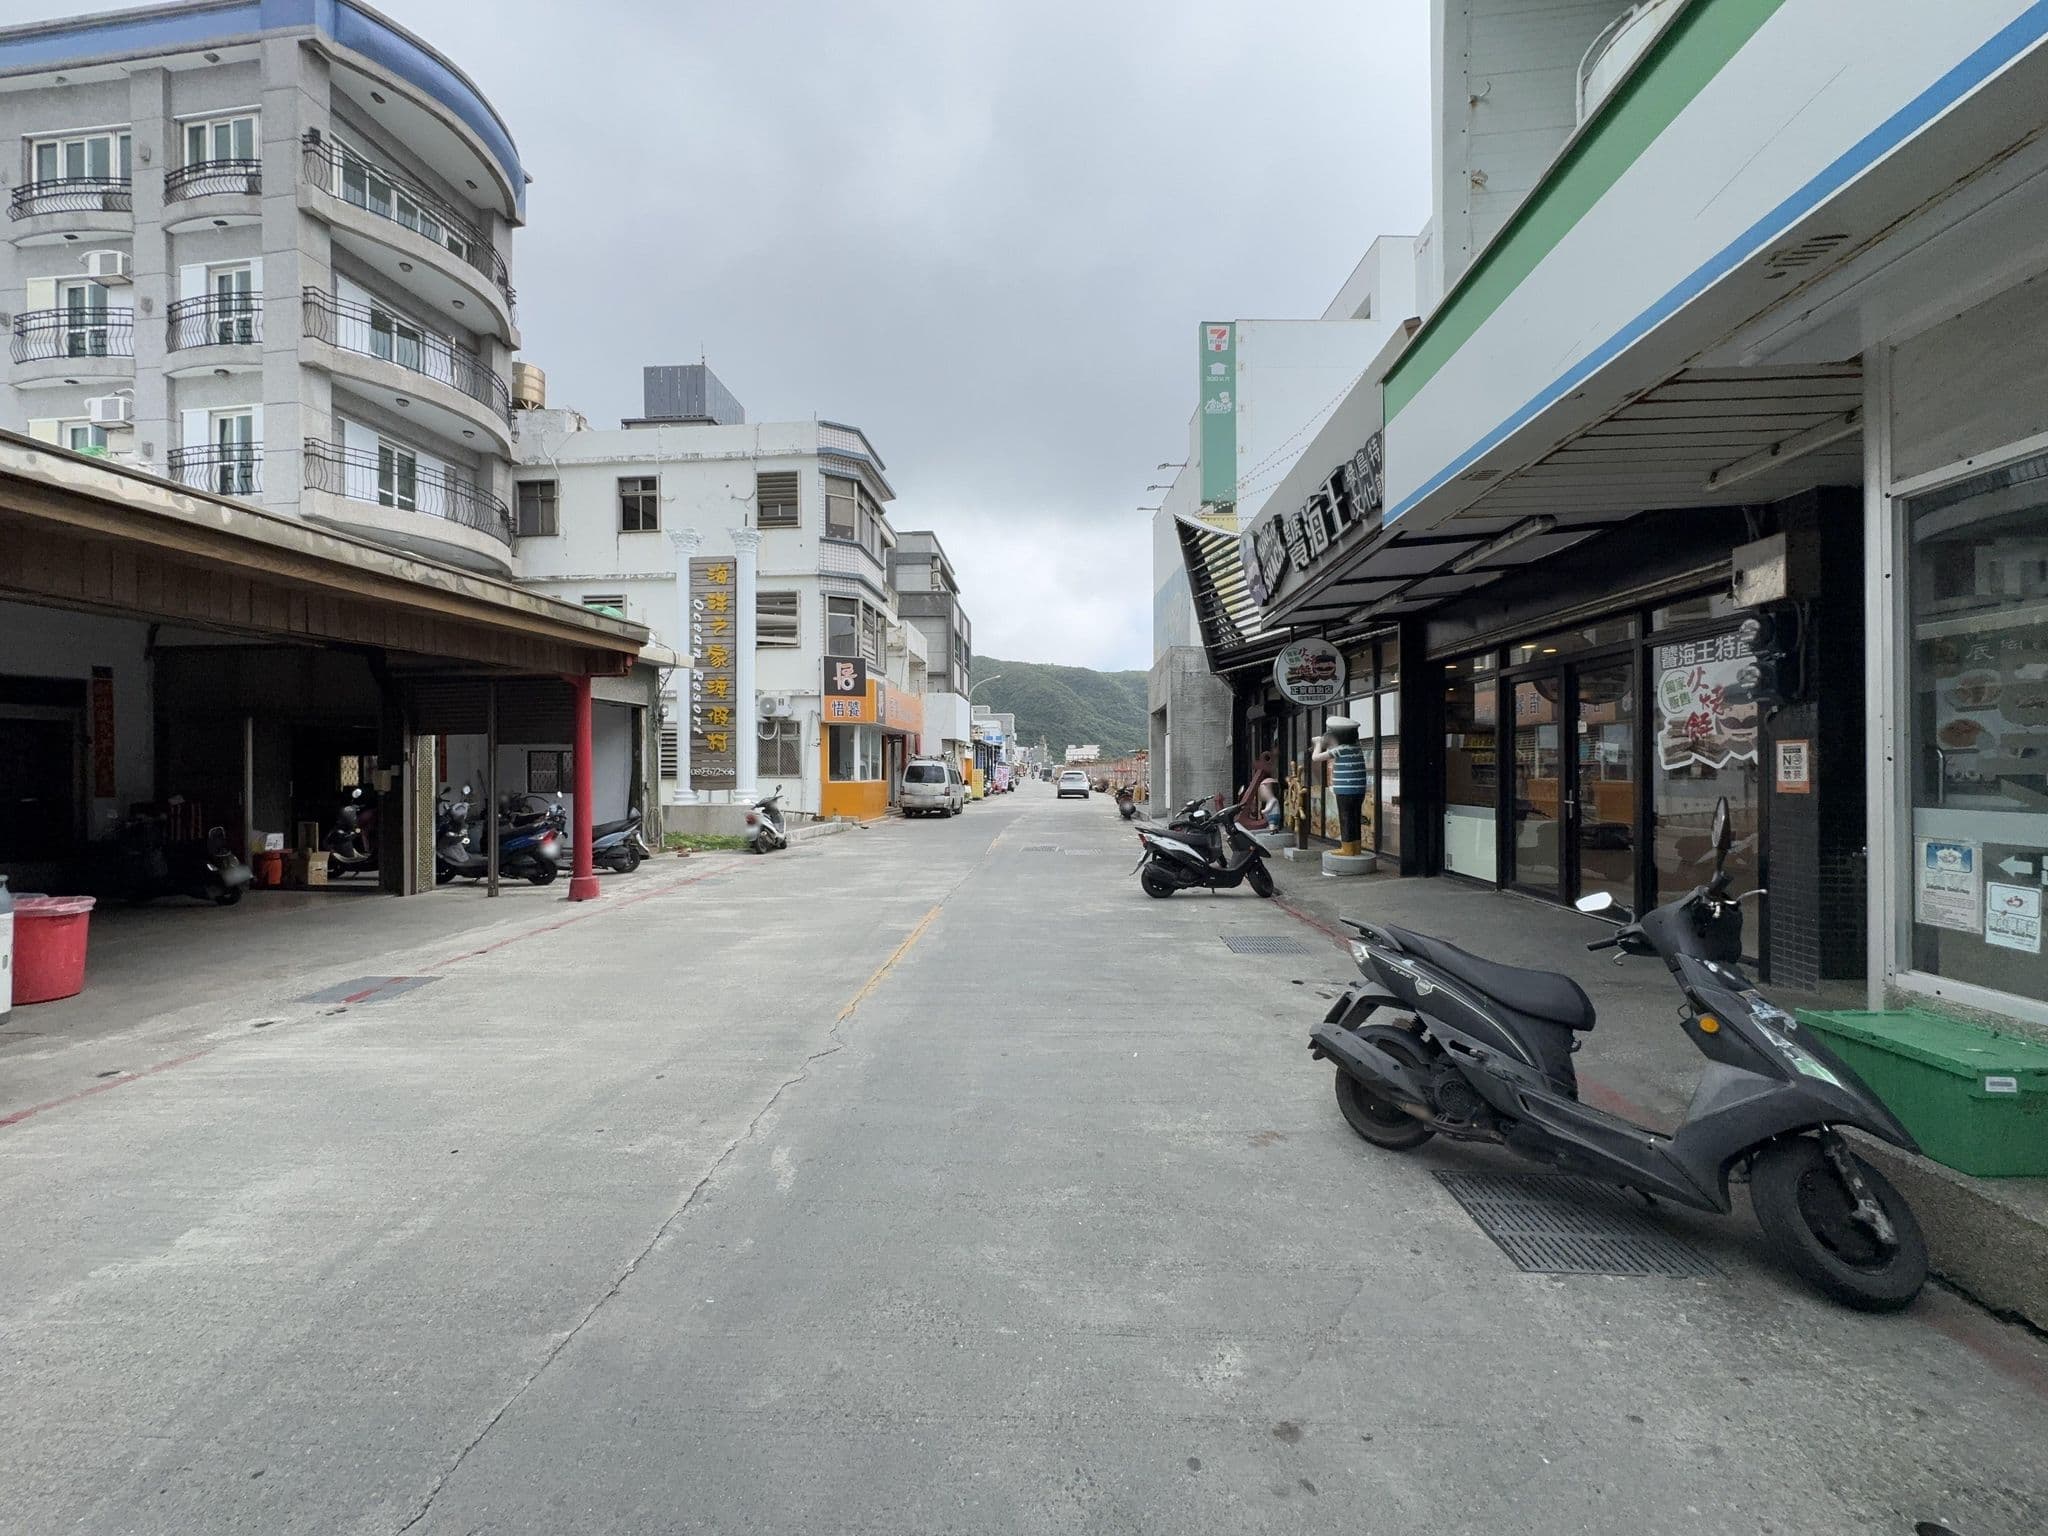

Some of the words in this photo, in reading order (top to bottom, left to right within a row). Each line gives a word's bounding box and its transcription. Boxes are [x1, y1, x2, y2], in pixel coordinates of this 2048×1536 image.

[1264, 537, 1287, 595] SNACK
[693, 598, 704, 659] Ocean
[692, 668, 704, 735] Resort
